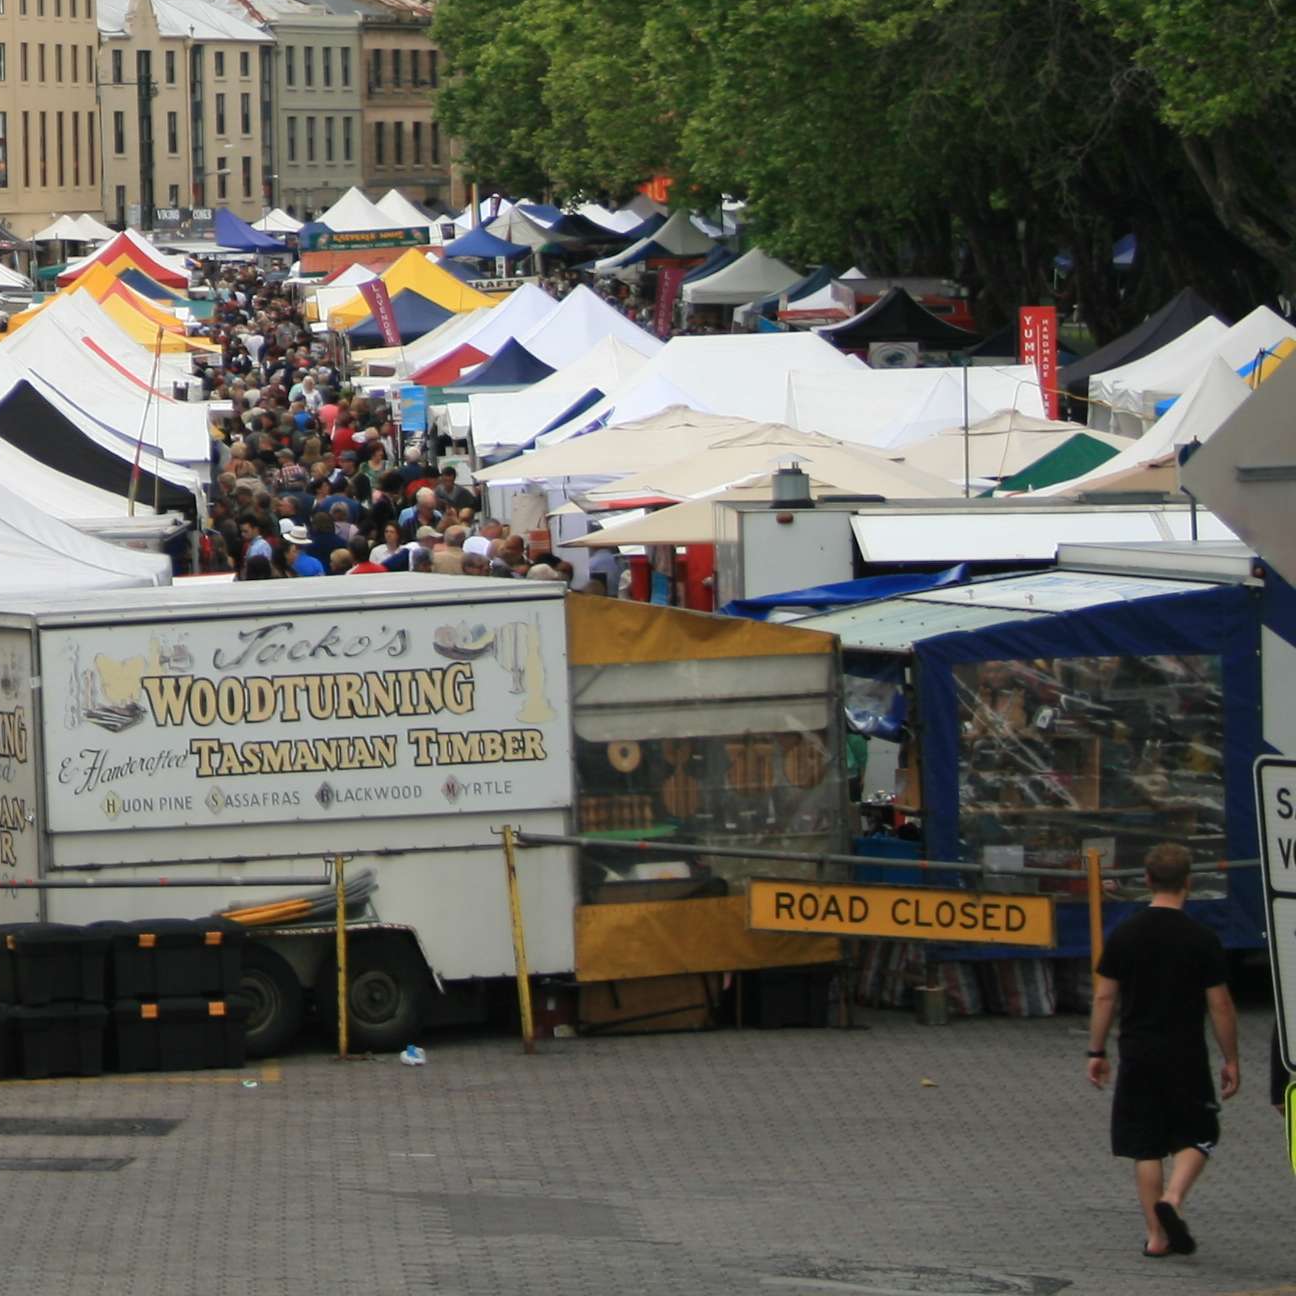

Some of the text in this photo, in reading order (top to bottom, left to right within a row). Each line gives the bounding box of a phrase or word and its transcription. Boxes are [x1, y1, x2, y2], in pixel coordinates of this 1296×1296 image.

[213, 622, 408, 670] Jacko's
[140, 662, 475, 727] WOODTURNING
[73, 747, 190, 796] Handcrafted
[189, 735, 398, 779] TASMANIAN
[407, 728, 548, 767] TIMBER
[106, 780, 513, 813] HUON PINE SASSAFRAS BLACKWOOD MYRTLE
[1276, 787, 1296, 820] S
[774, 892, 1026, 932] ROAD CLOSED
